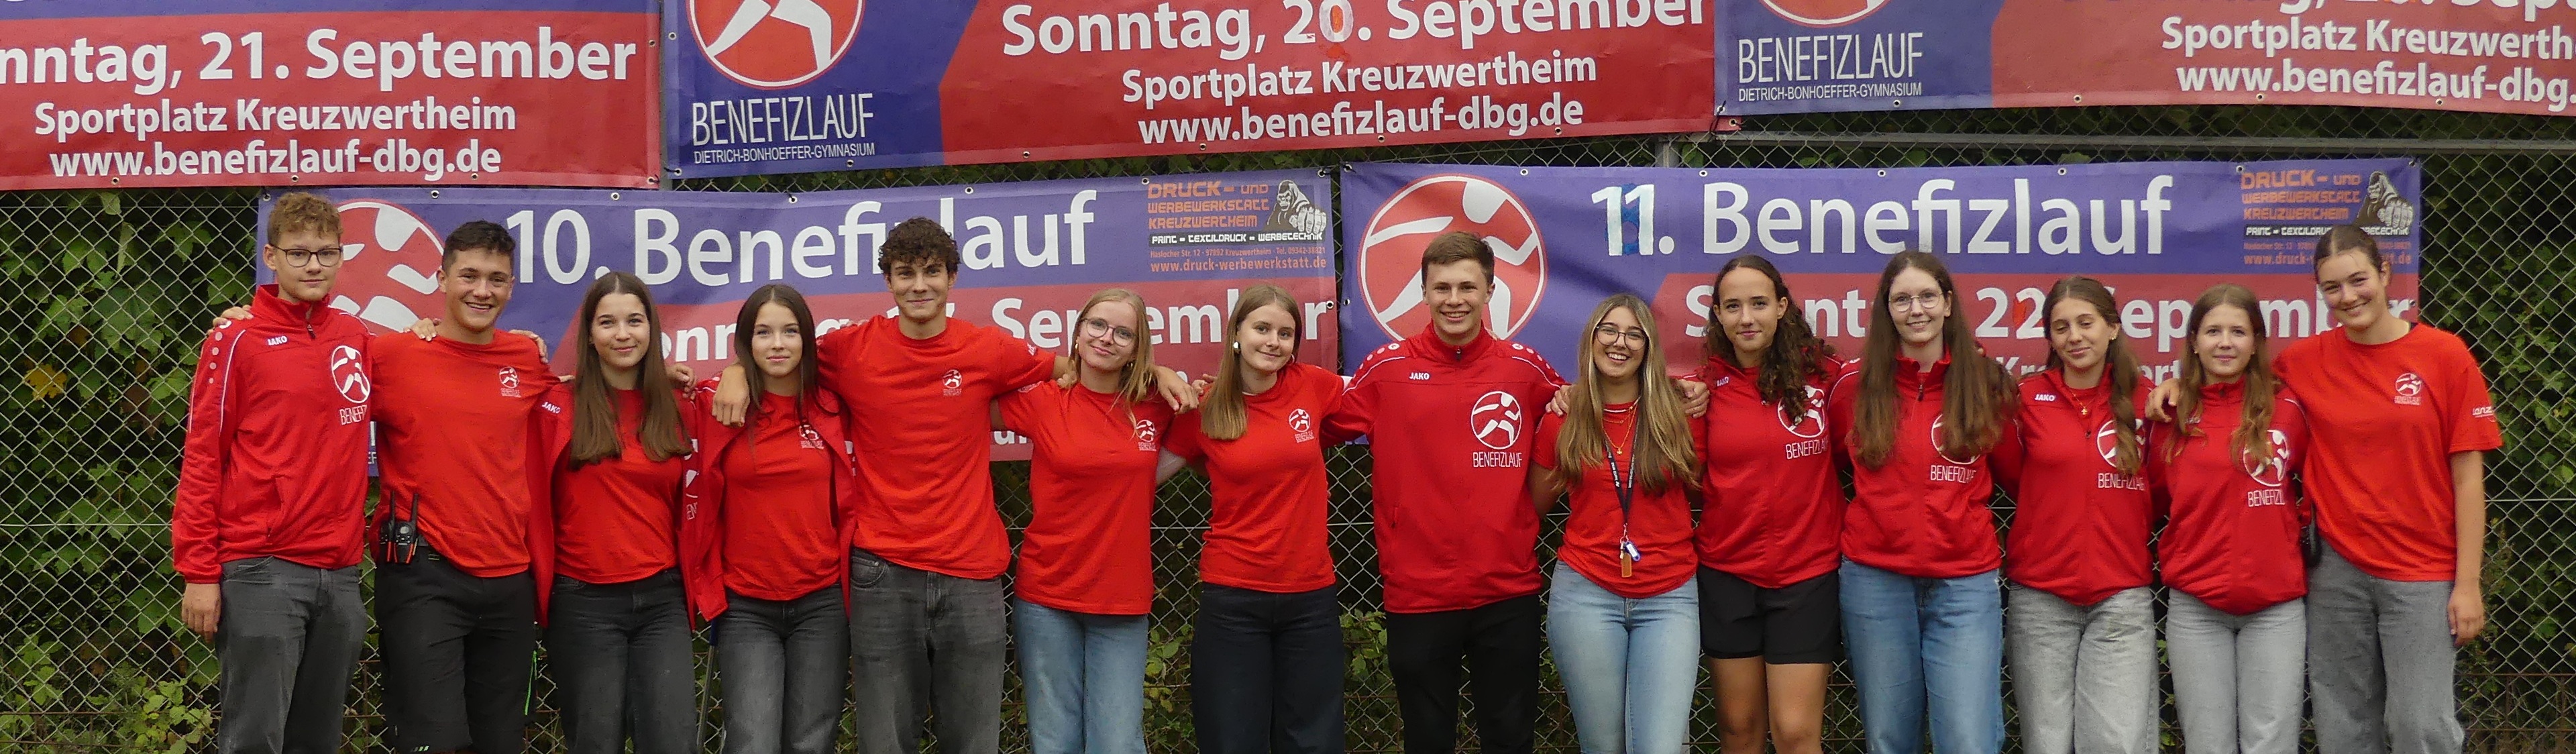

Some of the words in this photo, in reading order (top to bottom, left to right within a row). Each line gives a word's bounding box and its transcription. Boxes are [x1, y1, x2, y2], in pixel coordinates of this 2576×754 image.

[1002, 2, 1266, 60] Sonntag,
[1283, 0, 1371, 44] 20.
[1387, 0, 1703, 50] September
[2161, 16, 2357, 57] Sportplatz
[2366, 19, 2576, 60] Kreuzwerth
[200, 31, 290, 80] 21.
[306, 26, 636, 92] September
[1739, 32, 1923, 83] BENEFIZLAUF
[1122, 64, 1313, 110] Sportplatz
[1323, 50, 1597, 93] Kreuzwertheim
[1739, 83, 1921, 102] DIETRICH-BONHOEFFER-GYMNASIUM
[35, 97, 227, 142] Sportplatz
[236, 96, 516, 131] Kreuzwertheim
[692, 93, 874, 146] BENEFIZLAUF
[1138, 92, 1584, 144] www.benefizlauf-dbg.de
[49, 138, 502, 182] www.benefizlauf-dbg.de
[694, 143, 875, 164] DIETRICH-BONHOEFFER-GYMNASIUM
[1148, 199, 1270, 214] WERBEWERKSTATT
[2242, 191, 2361, 204] WERBEWERKSTATT
[1148, 215, 1258, 229] KREUZWERTHEIM
[1591, 183, 1675, 256] 11.
[1703, 174, 2173, 255] Benefizlauf
[2243, 207, 2350, 220] KREUZWERTHEIM
[506, 209, 610, 284] 10.
[635, 190, 1097, 286] Benefilauf
[1152, 235, 1177, 244] PRINT
[1188, 233, 1246, 243] TEXTILDRUCK
[1258, 232, 1323, 242] WERBETECHNIK
[2246, 227, 2271, 235] PRINT
[1150, 256, 1326, 272] www.druck-werbewerkstatt.de
[1409, 372, 1430, 380] JAKO
[541, 401, 561, 414] JAKO
[2034, 394, 2056, 402] JAKO
[1472, 451, 1523, 468] BENEFIZLAUF
